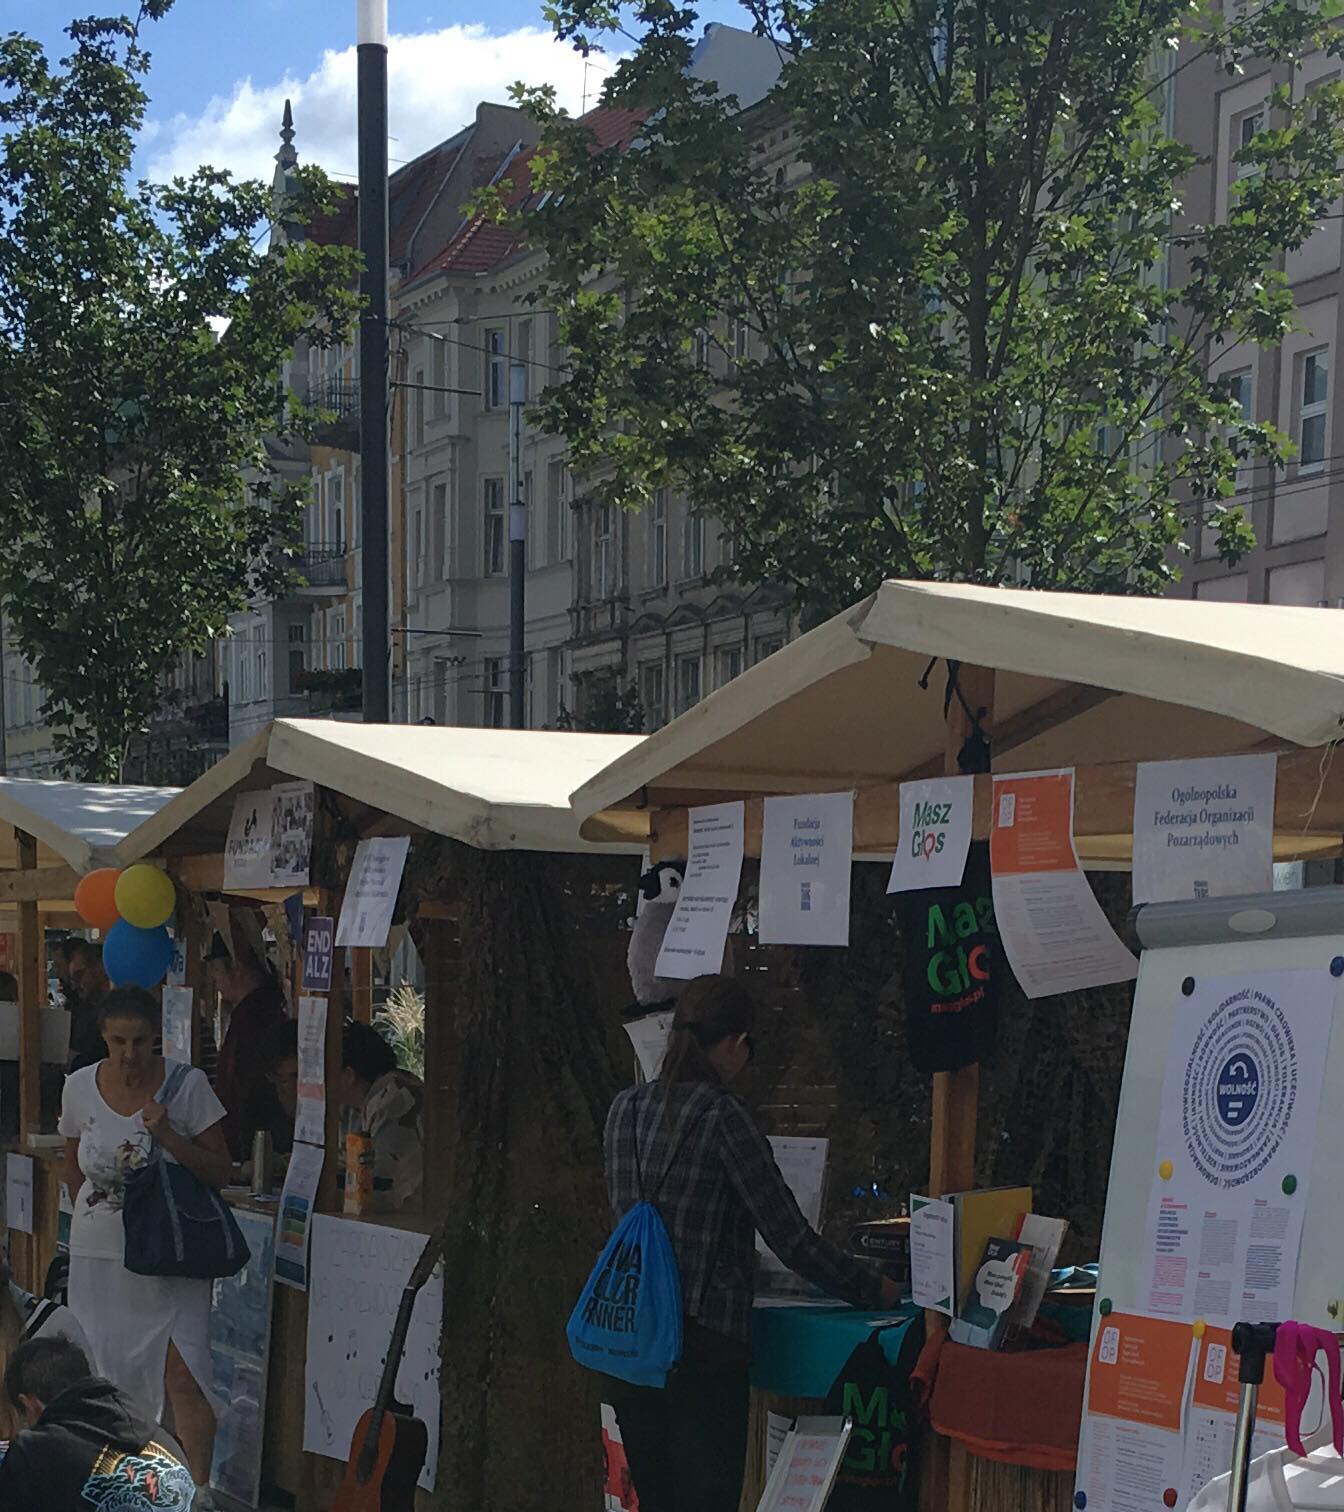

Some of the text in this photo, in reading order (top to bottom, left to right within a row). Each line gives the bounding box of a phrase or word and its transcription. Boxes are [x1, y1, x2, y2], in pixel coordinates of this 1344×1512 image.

[912, 802, 953, 829] Masz
[1153, 806, 1255, 828] Federacja Organizacji
[1167, 829, 1239, 850] Pozarządowych
[306, 929, 331, 953] END
[305, 954, 330, 979] ALZ
